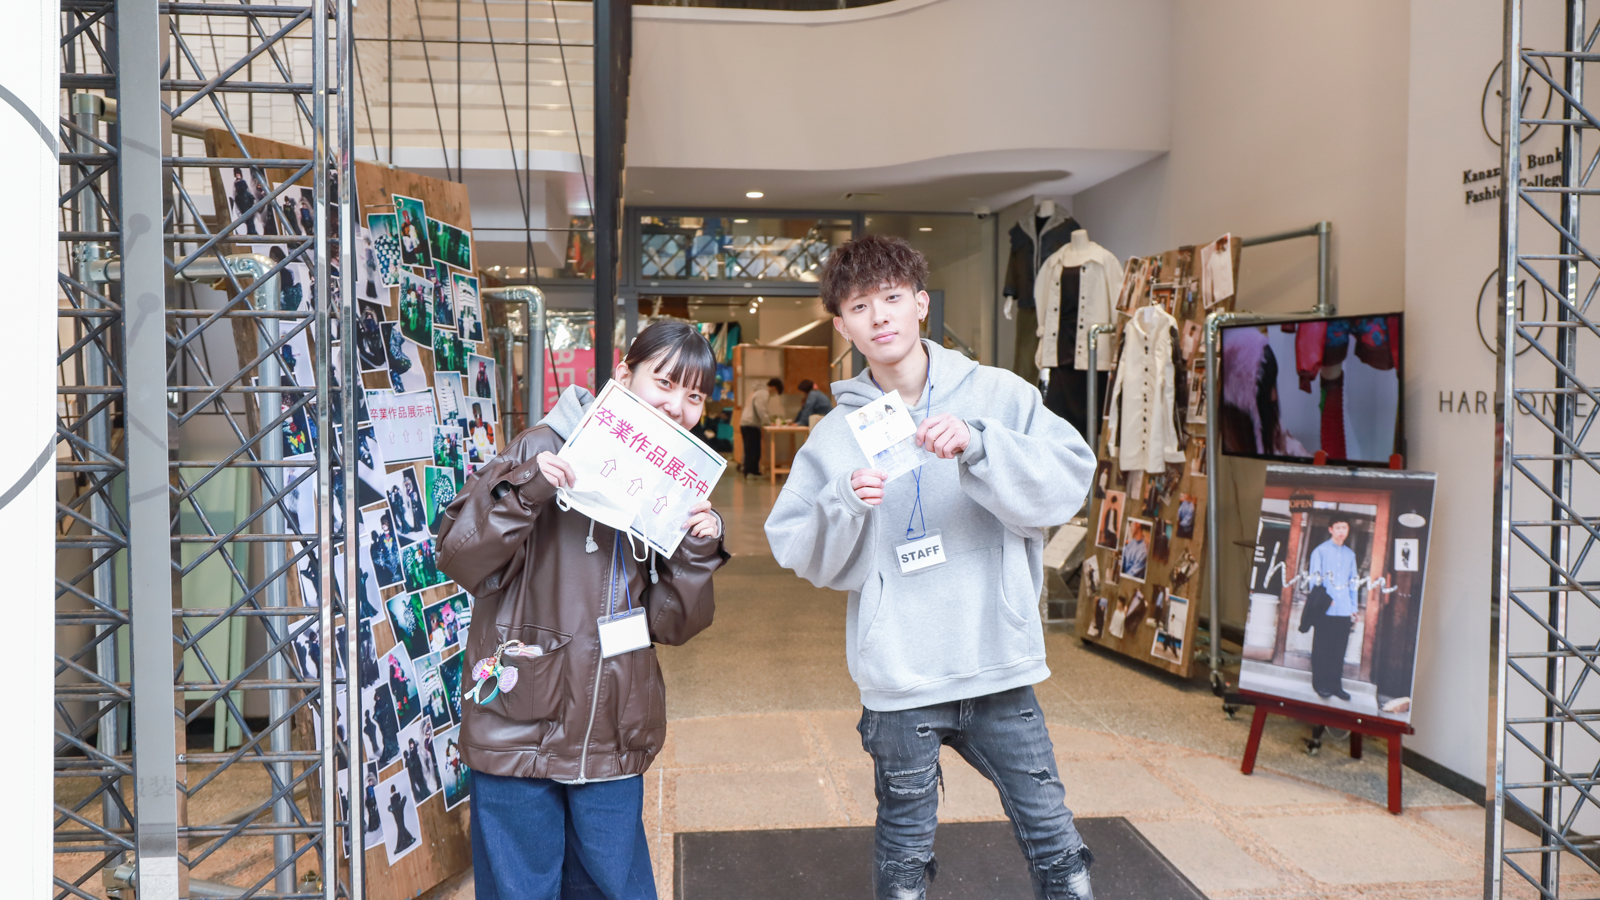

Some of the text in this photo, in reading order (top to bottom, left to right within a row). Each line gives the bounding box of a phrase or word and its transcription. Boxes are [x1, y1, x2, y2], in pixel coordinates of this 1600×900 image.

[1527, 147, 1562, 170] Bunk
[1465, 174, 1562, 204] Fashi Colleg
[370, 405, 433, 420] 卒業作品展示中
[1439, 390, 1587, 417] HARONE
[594, 406, 709, 497] 卒業作品展示中
[1290, 499, 1313, 509] OPEN
[901, 544, 940, 563] STAFF
